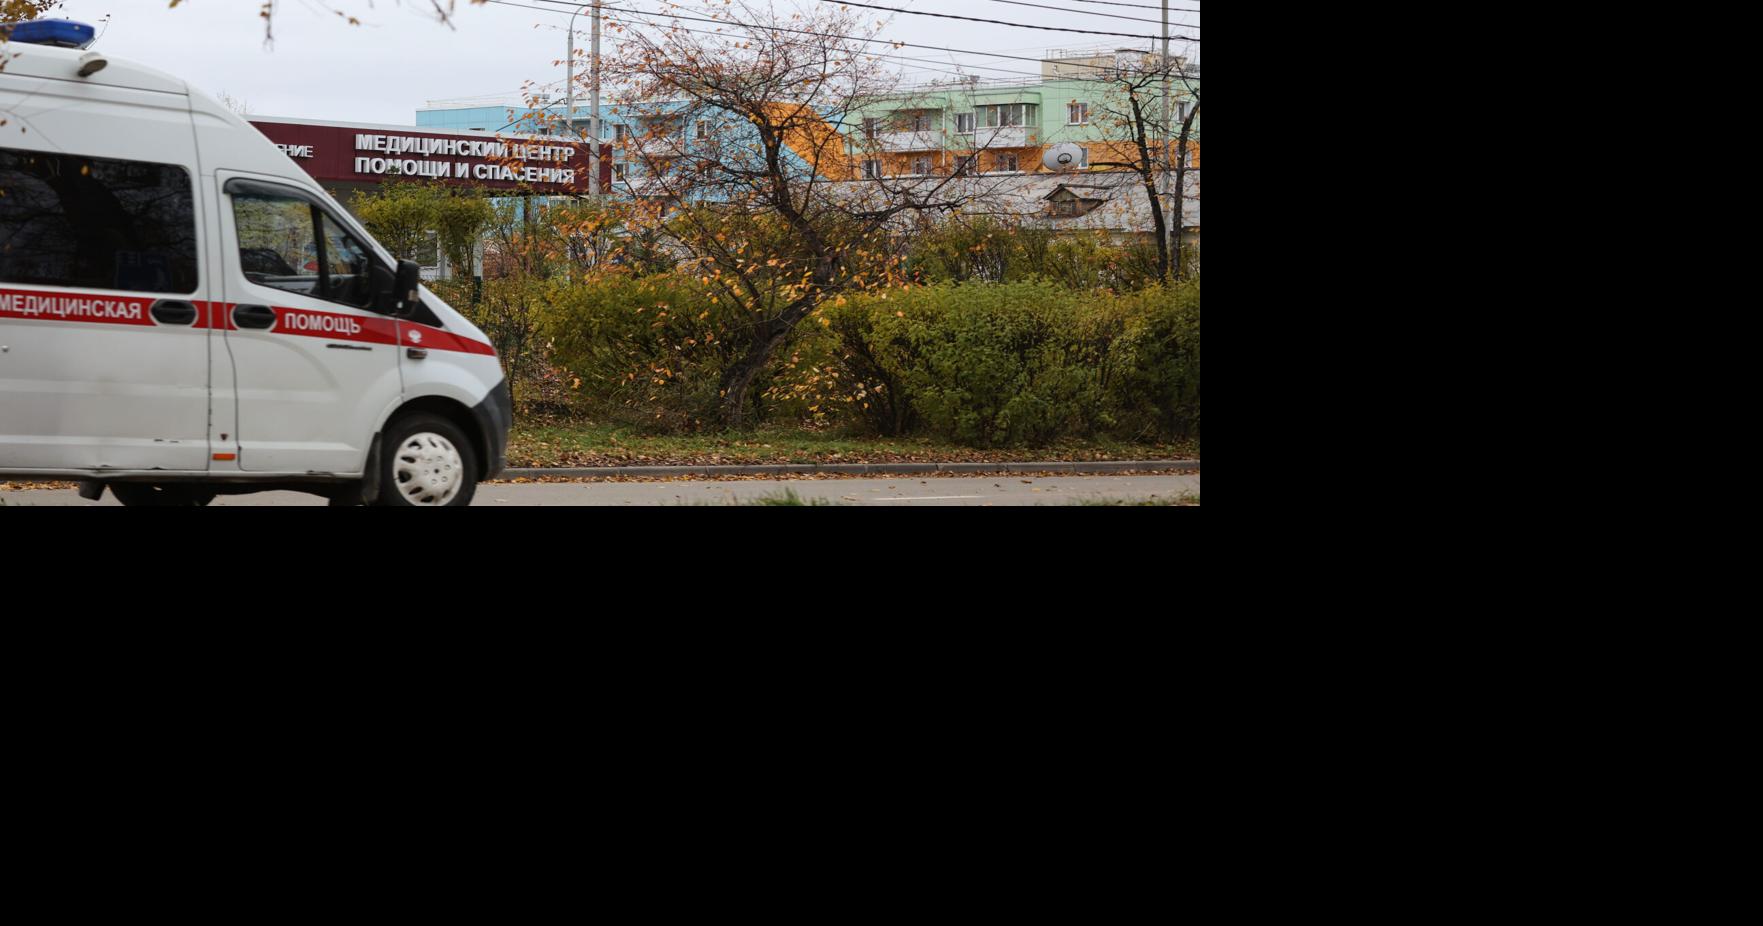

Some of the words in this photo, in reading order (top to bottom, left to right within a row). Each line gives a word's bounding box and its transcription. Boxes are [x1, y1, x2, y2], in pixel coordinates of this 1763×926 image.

[355, 134, 508, 157] МЕДИЦИНСКИЙ
[512, 143, 575, 162] ЦЕНТР
[355, 157, 450, 179] ПОМОЩИ
[454, 163, 469, 178] И
[473, 164, 575, 184] СПАСЕНИЯ
[0, 294, 142, 319] МЕДИЦИНСКАЯ
[284, 312, 361, 336] ПОМОЩЬ
